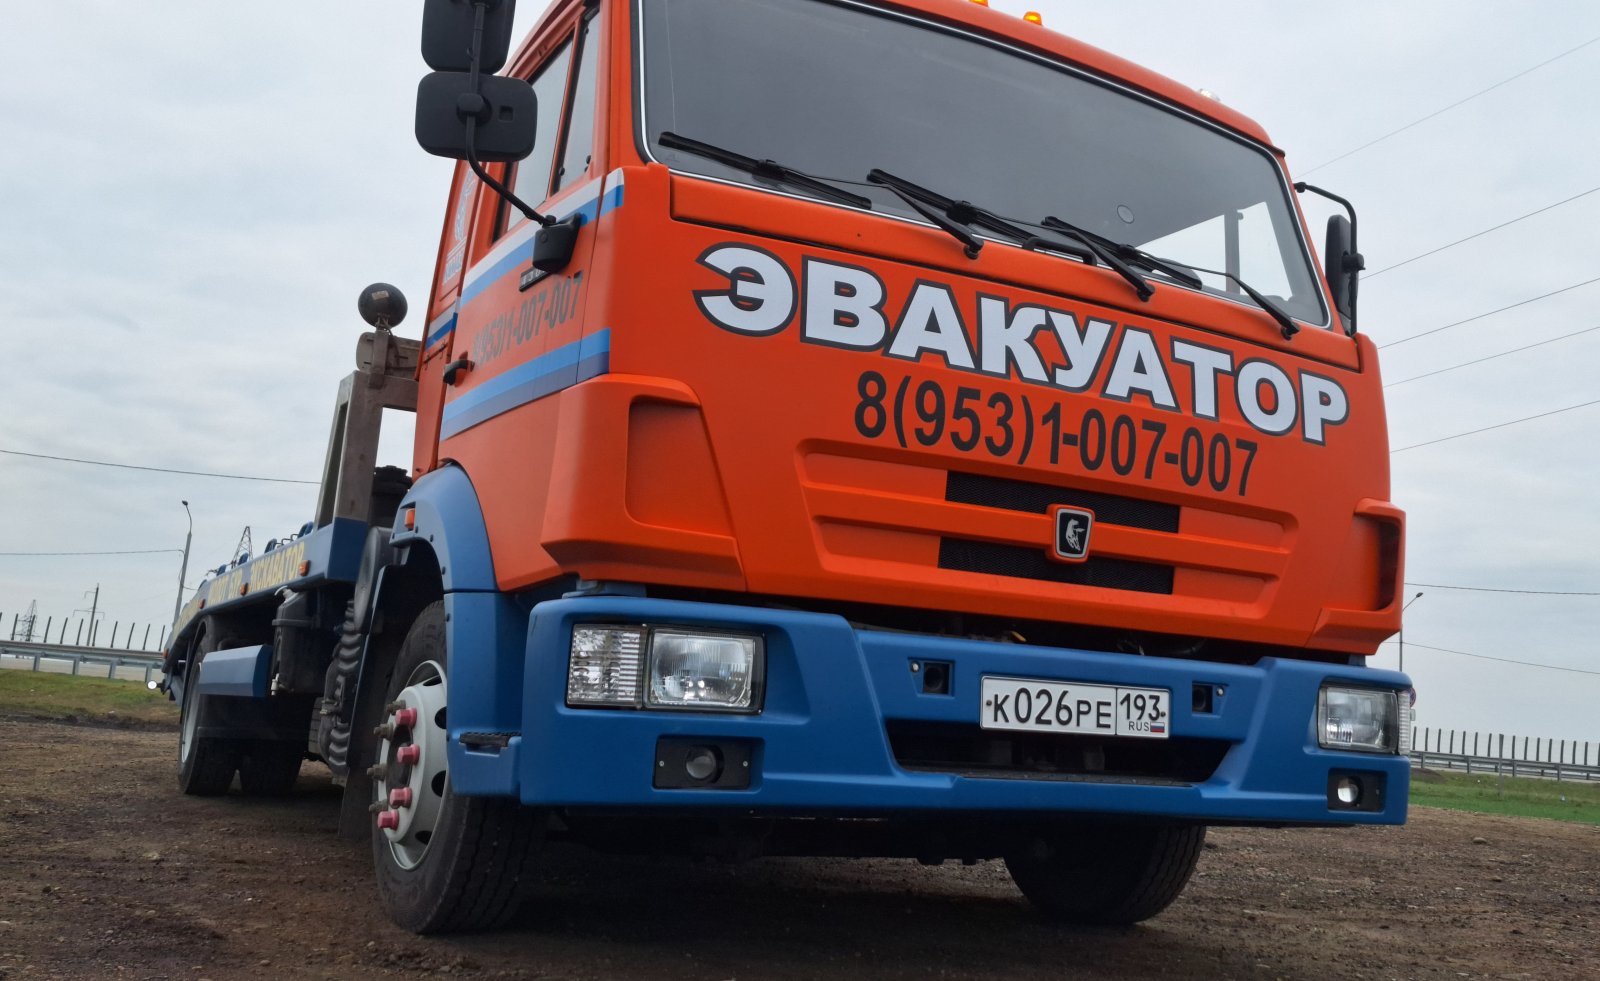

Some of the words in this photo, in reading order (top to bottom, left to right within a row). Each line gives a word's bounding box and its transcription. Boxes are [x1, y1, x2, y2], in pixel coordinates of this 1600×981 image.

[692, 243, 1350, 447] ЭВАКУАТОР
[855, 370, 1258, 496] 8(953)1-007-007
[993, 687, 1112, 729] К026РЕ
[1119, 693, 1161, 721] 193
[1128, 720, 1150, 732] RUS
